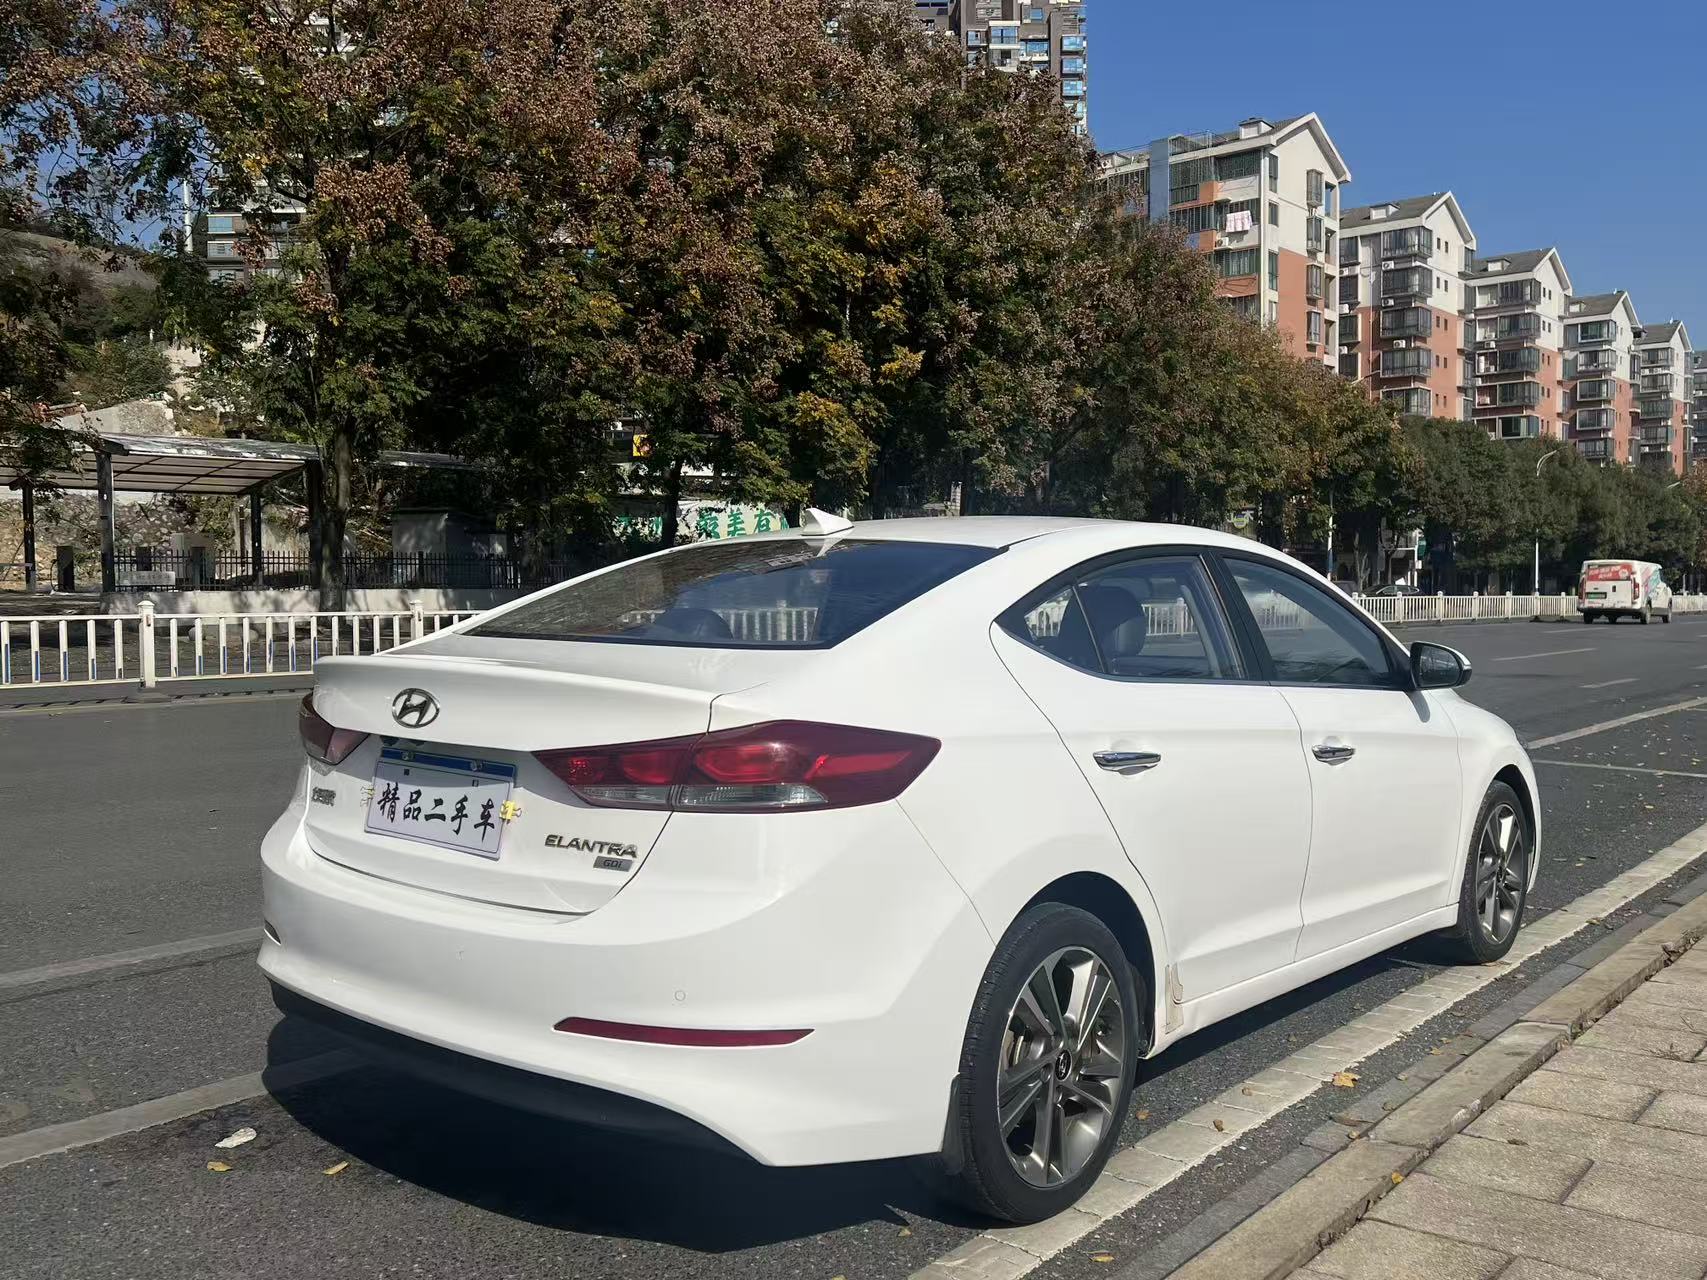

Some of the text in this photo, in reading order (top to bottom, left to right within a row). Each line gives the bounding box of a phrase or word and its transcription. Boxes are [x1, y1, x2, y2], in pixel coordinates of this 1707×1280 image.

[377, 781, 495, 842] 精品二手车
[544, 834, 637, 859] ELANTRA
